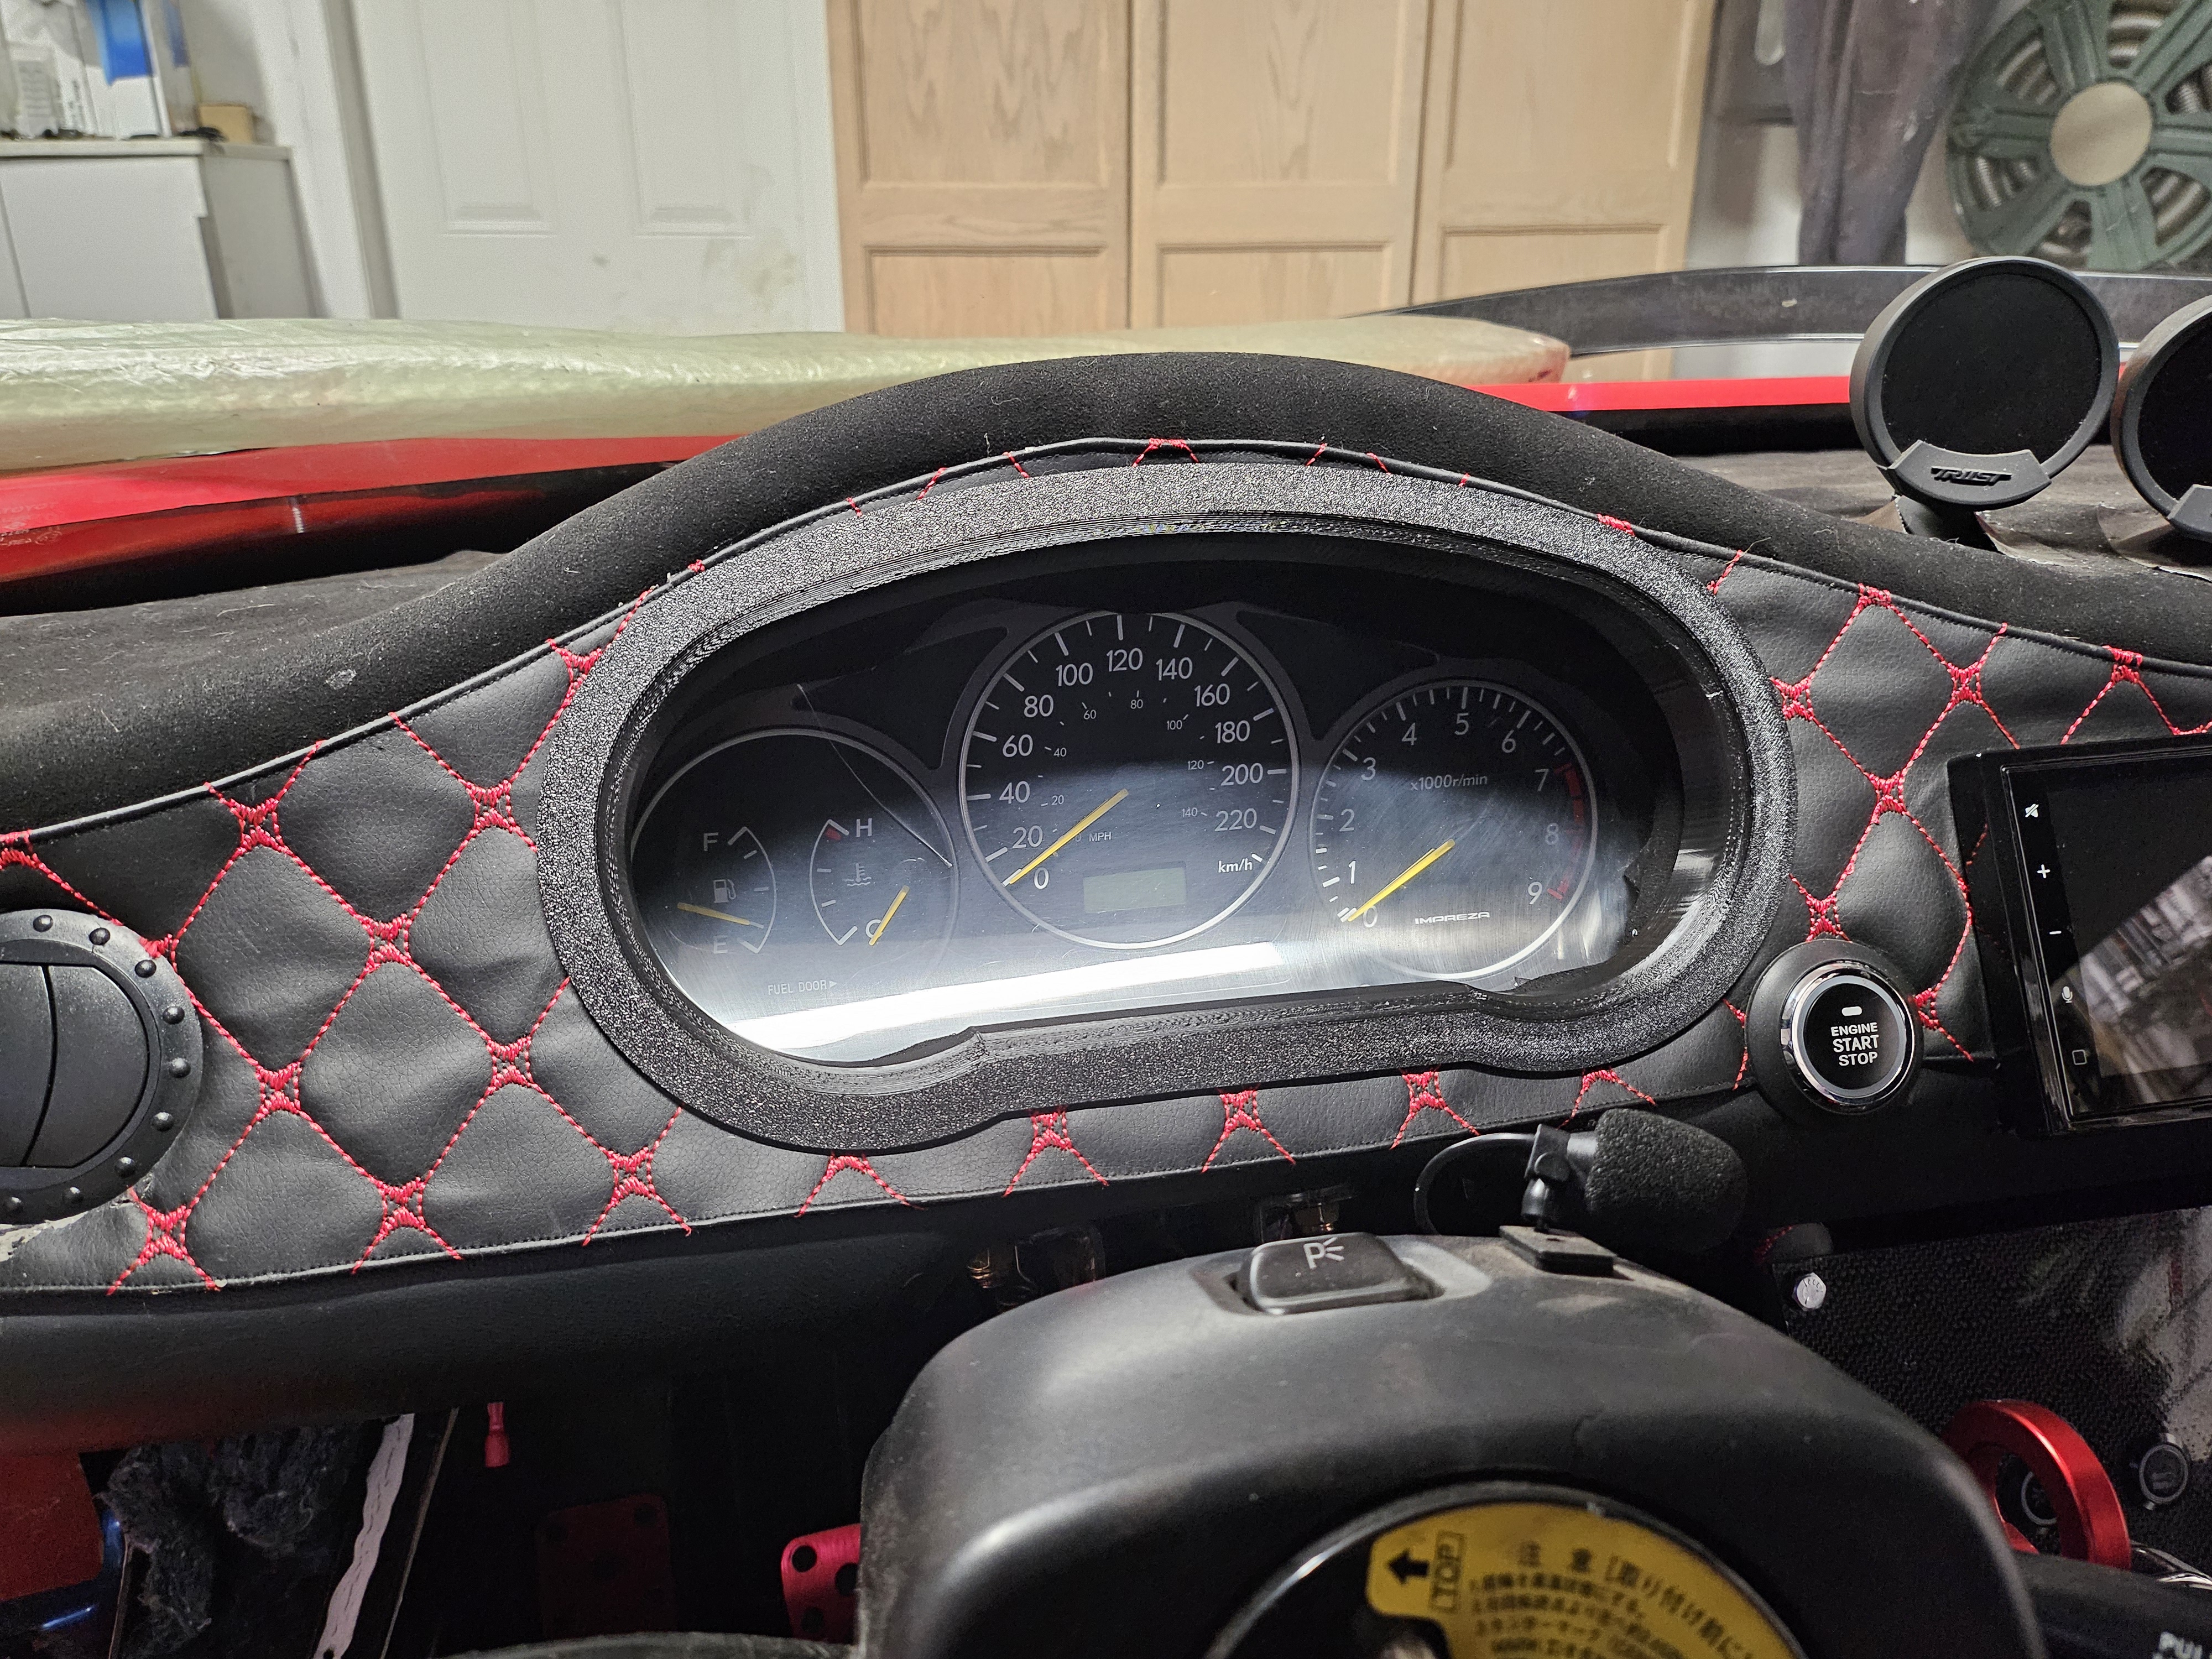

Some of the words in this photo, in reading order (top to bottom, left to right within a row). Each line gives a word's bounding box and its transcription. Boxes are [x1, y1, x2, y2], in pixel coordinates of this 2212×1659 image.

[1106, 648, 1143, 672] 120
[1156, 657, 1193, 681] 140
[1056, 662, 1093, 686] 100
[1024, 694, 1054, 718] 80
[1130, 698, 1144, 709] 80
[1194, 683, 1230, 707] 160
[1083, 709, 1097, 720] 60
[1166, 719, 1183, 730] 100
[1454, 712, 1469, 735] 5
[1215, 720, 1250, 744] 180
[1401, 722, 1417, 745] 4
[1501, 729, 1516, 753] 6
[1002, 734, 1033, 758] 60
[1053, 747, 1067, 757] 40
[1187, 759, 1204, 770] 120
[1220, 763, 1264, 786] 200
[1361, 757, 1376, 781] 3
[1535, 768, 1549, 792] 7
[999, 781, 1030, 804] 40
[1051, 794, 1065, 806] 20
[1182, 807, 1198, 817] 140
[1214, 808, 1257, 832] 220
[1339, 808, 1355, 832] 2
[856, 817, 873, 837] H
[1012, 825, 1043, 849] 20
[1089, 831, 1112, 842] MPH
[1545, 822, 1559, 845] 8
[703, 832, 719, 852] F
[1218, 858, 1253, 873] km/h
[1348, 860, 1356, 884] 1
[1034, 867, 1050, 889] 0
[1528, 881, 1542, 905] 9
[1363, 905, 1378, 927] 0
[1415, 911, 1490, 925] IMPREZA
[865, 919, 883, 939] C
[713, 935, 728, 954] E
[768, 983, 794, 995] FUEL
[798, 979, 827, 992] DOOR
[1830, 1022, 1878, 1037] ENGINE
[1833, 1034, 1879, 1053] START
[1839, 1051, 1878, 1066] STOP
